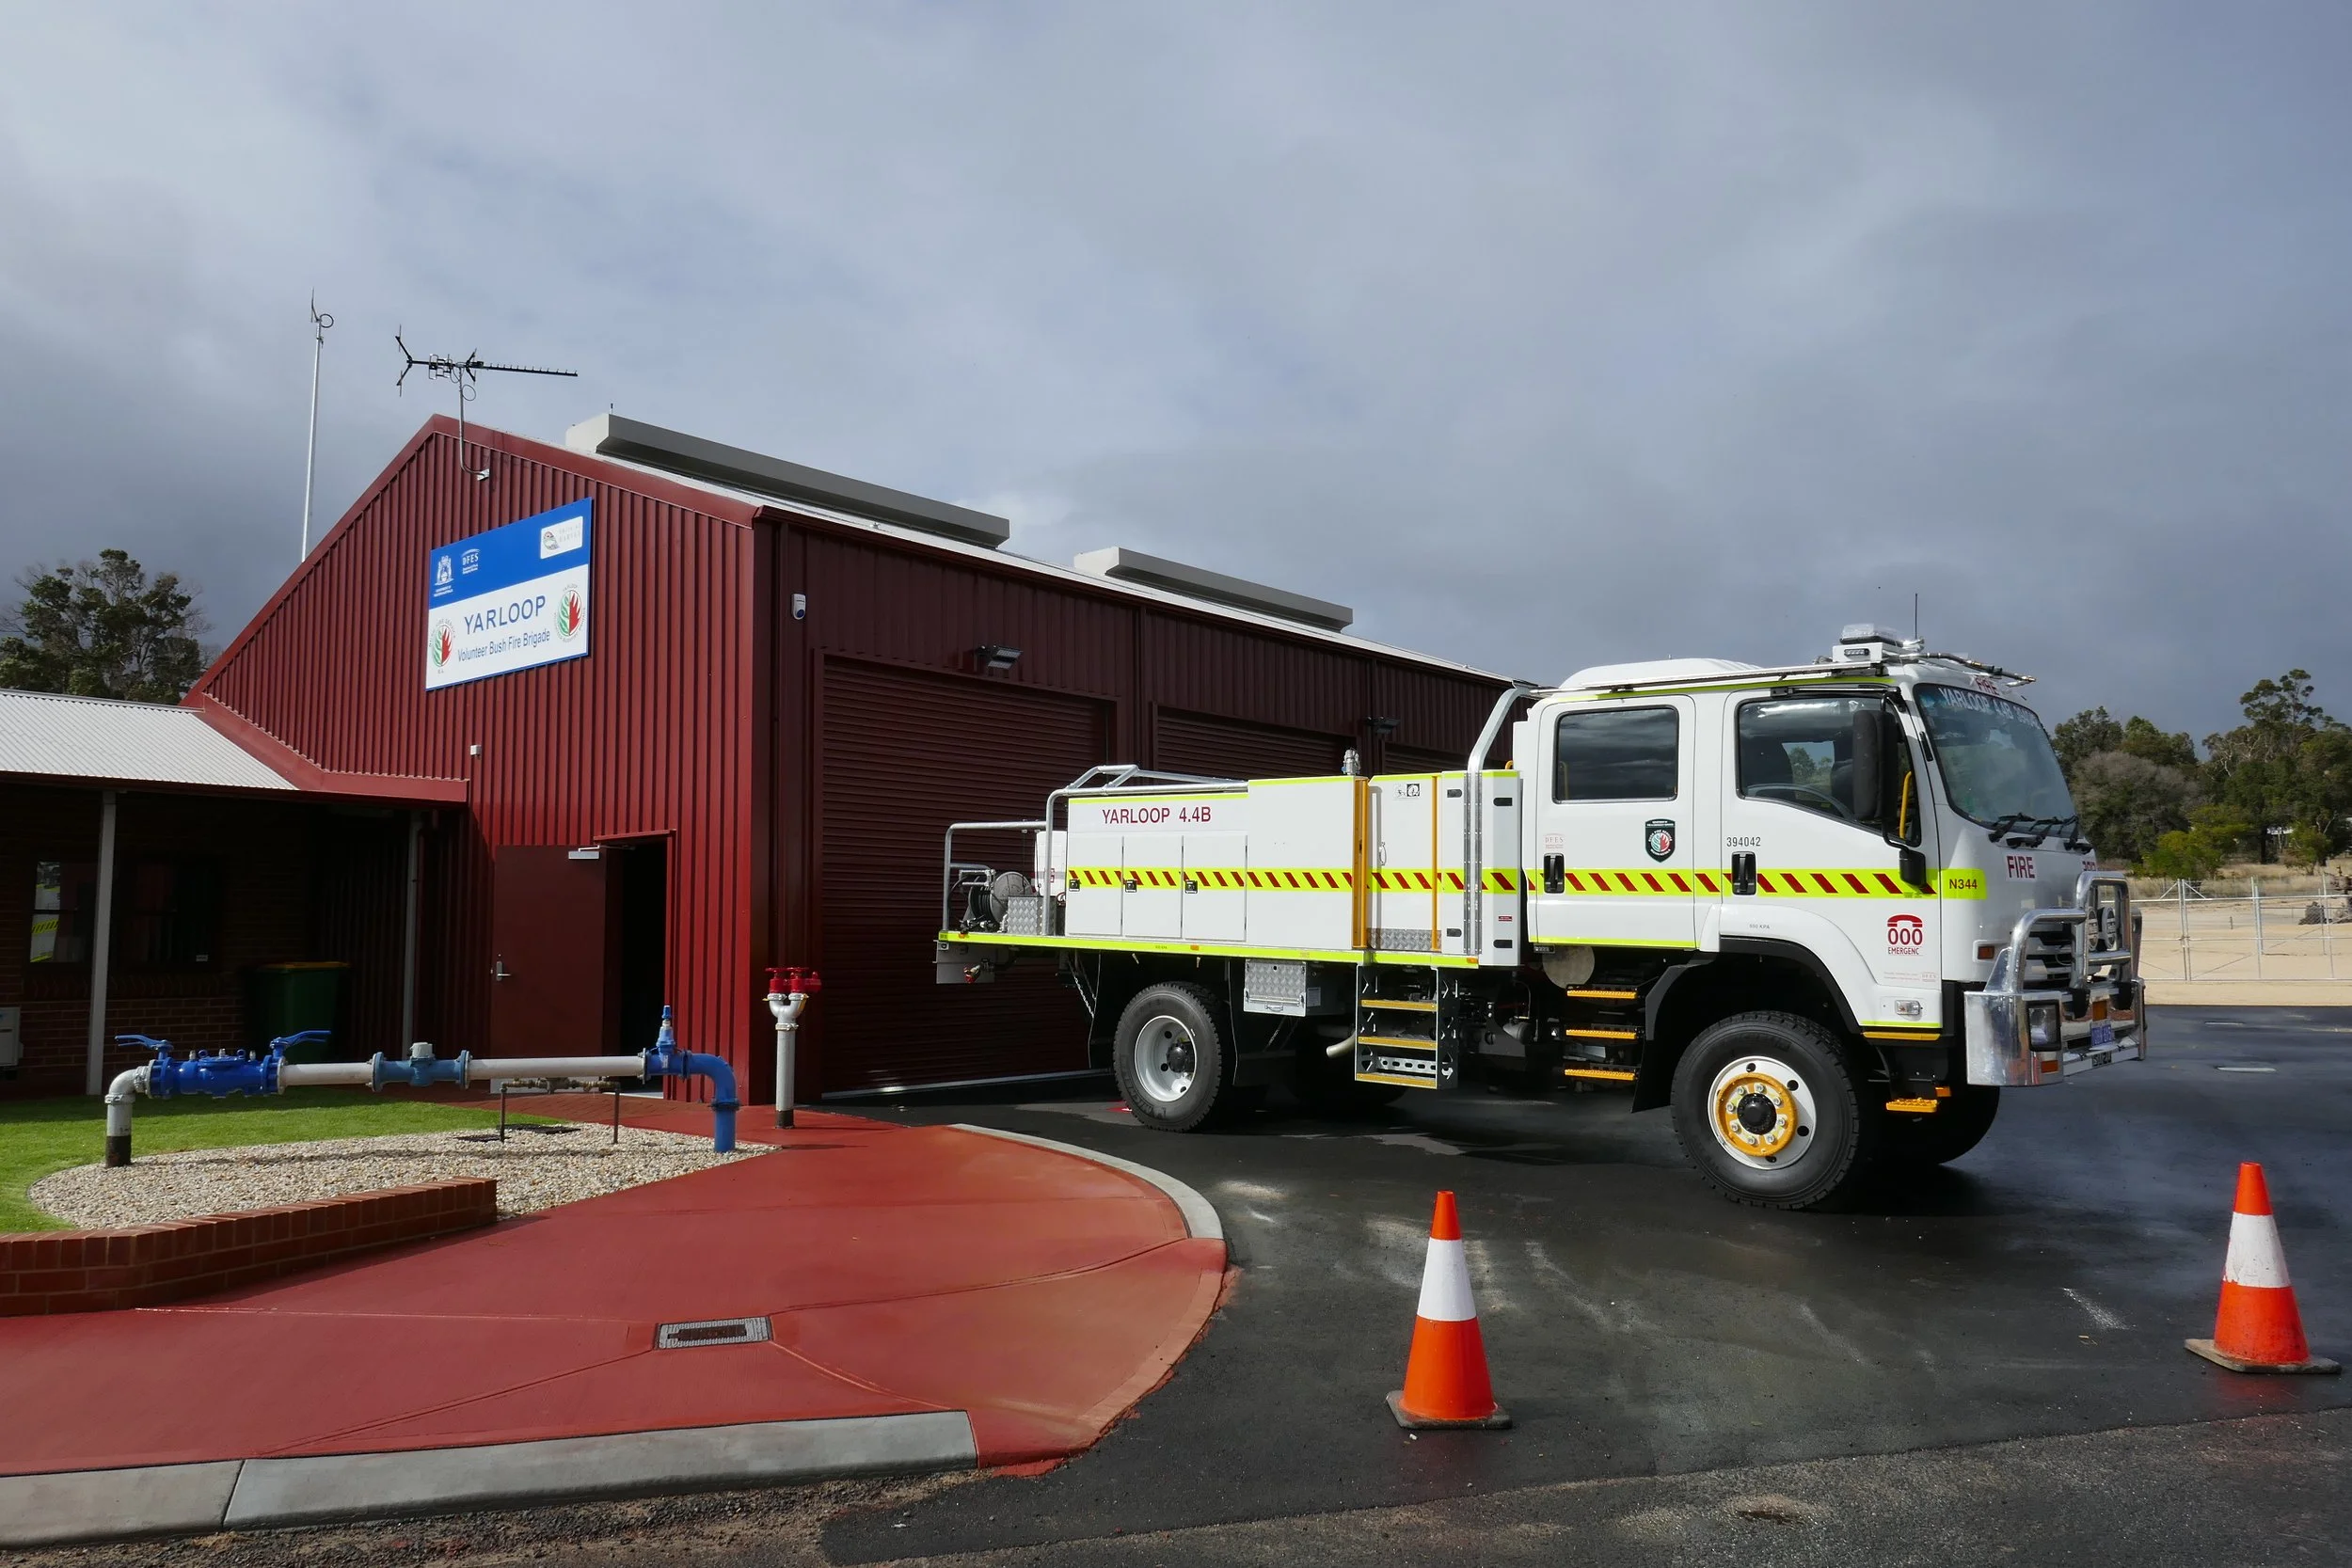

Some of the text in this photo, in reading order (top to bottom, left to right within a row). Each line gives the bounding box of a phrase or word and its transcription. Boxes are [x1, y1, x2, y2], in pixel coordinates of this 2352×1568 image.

[462, 553, 479, 565] DFES
[464, 594, 546, 636] YARLOOP
[457, 628, 550, 662] Volunteer Bush Fire Brigade
[1976, 676, 2000, 696] FIRE
[1938, 688, 1991, 714] YARLOOP
[1102, 806, 1211, 824] YARLOOP 4.4B
[1726, 836, 1761, 847] 394042
[2006, 855, 2035, 879] FIRE
[1948, 879, 1978, 890] N344
[1887, 927, 1923, 946] 000
